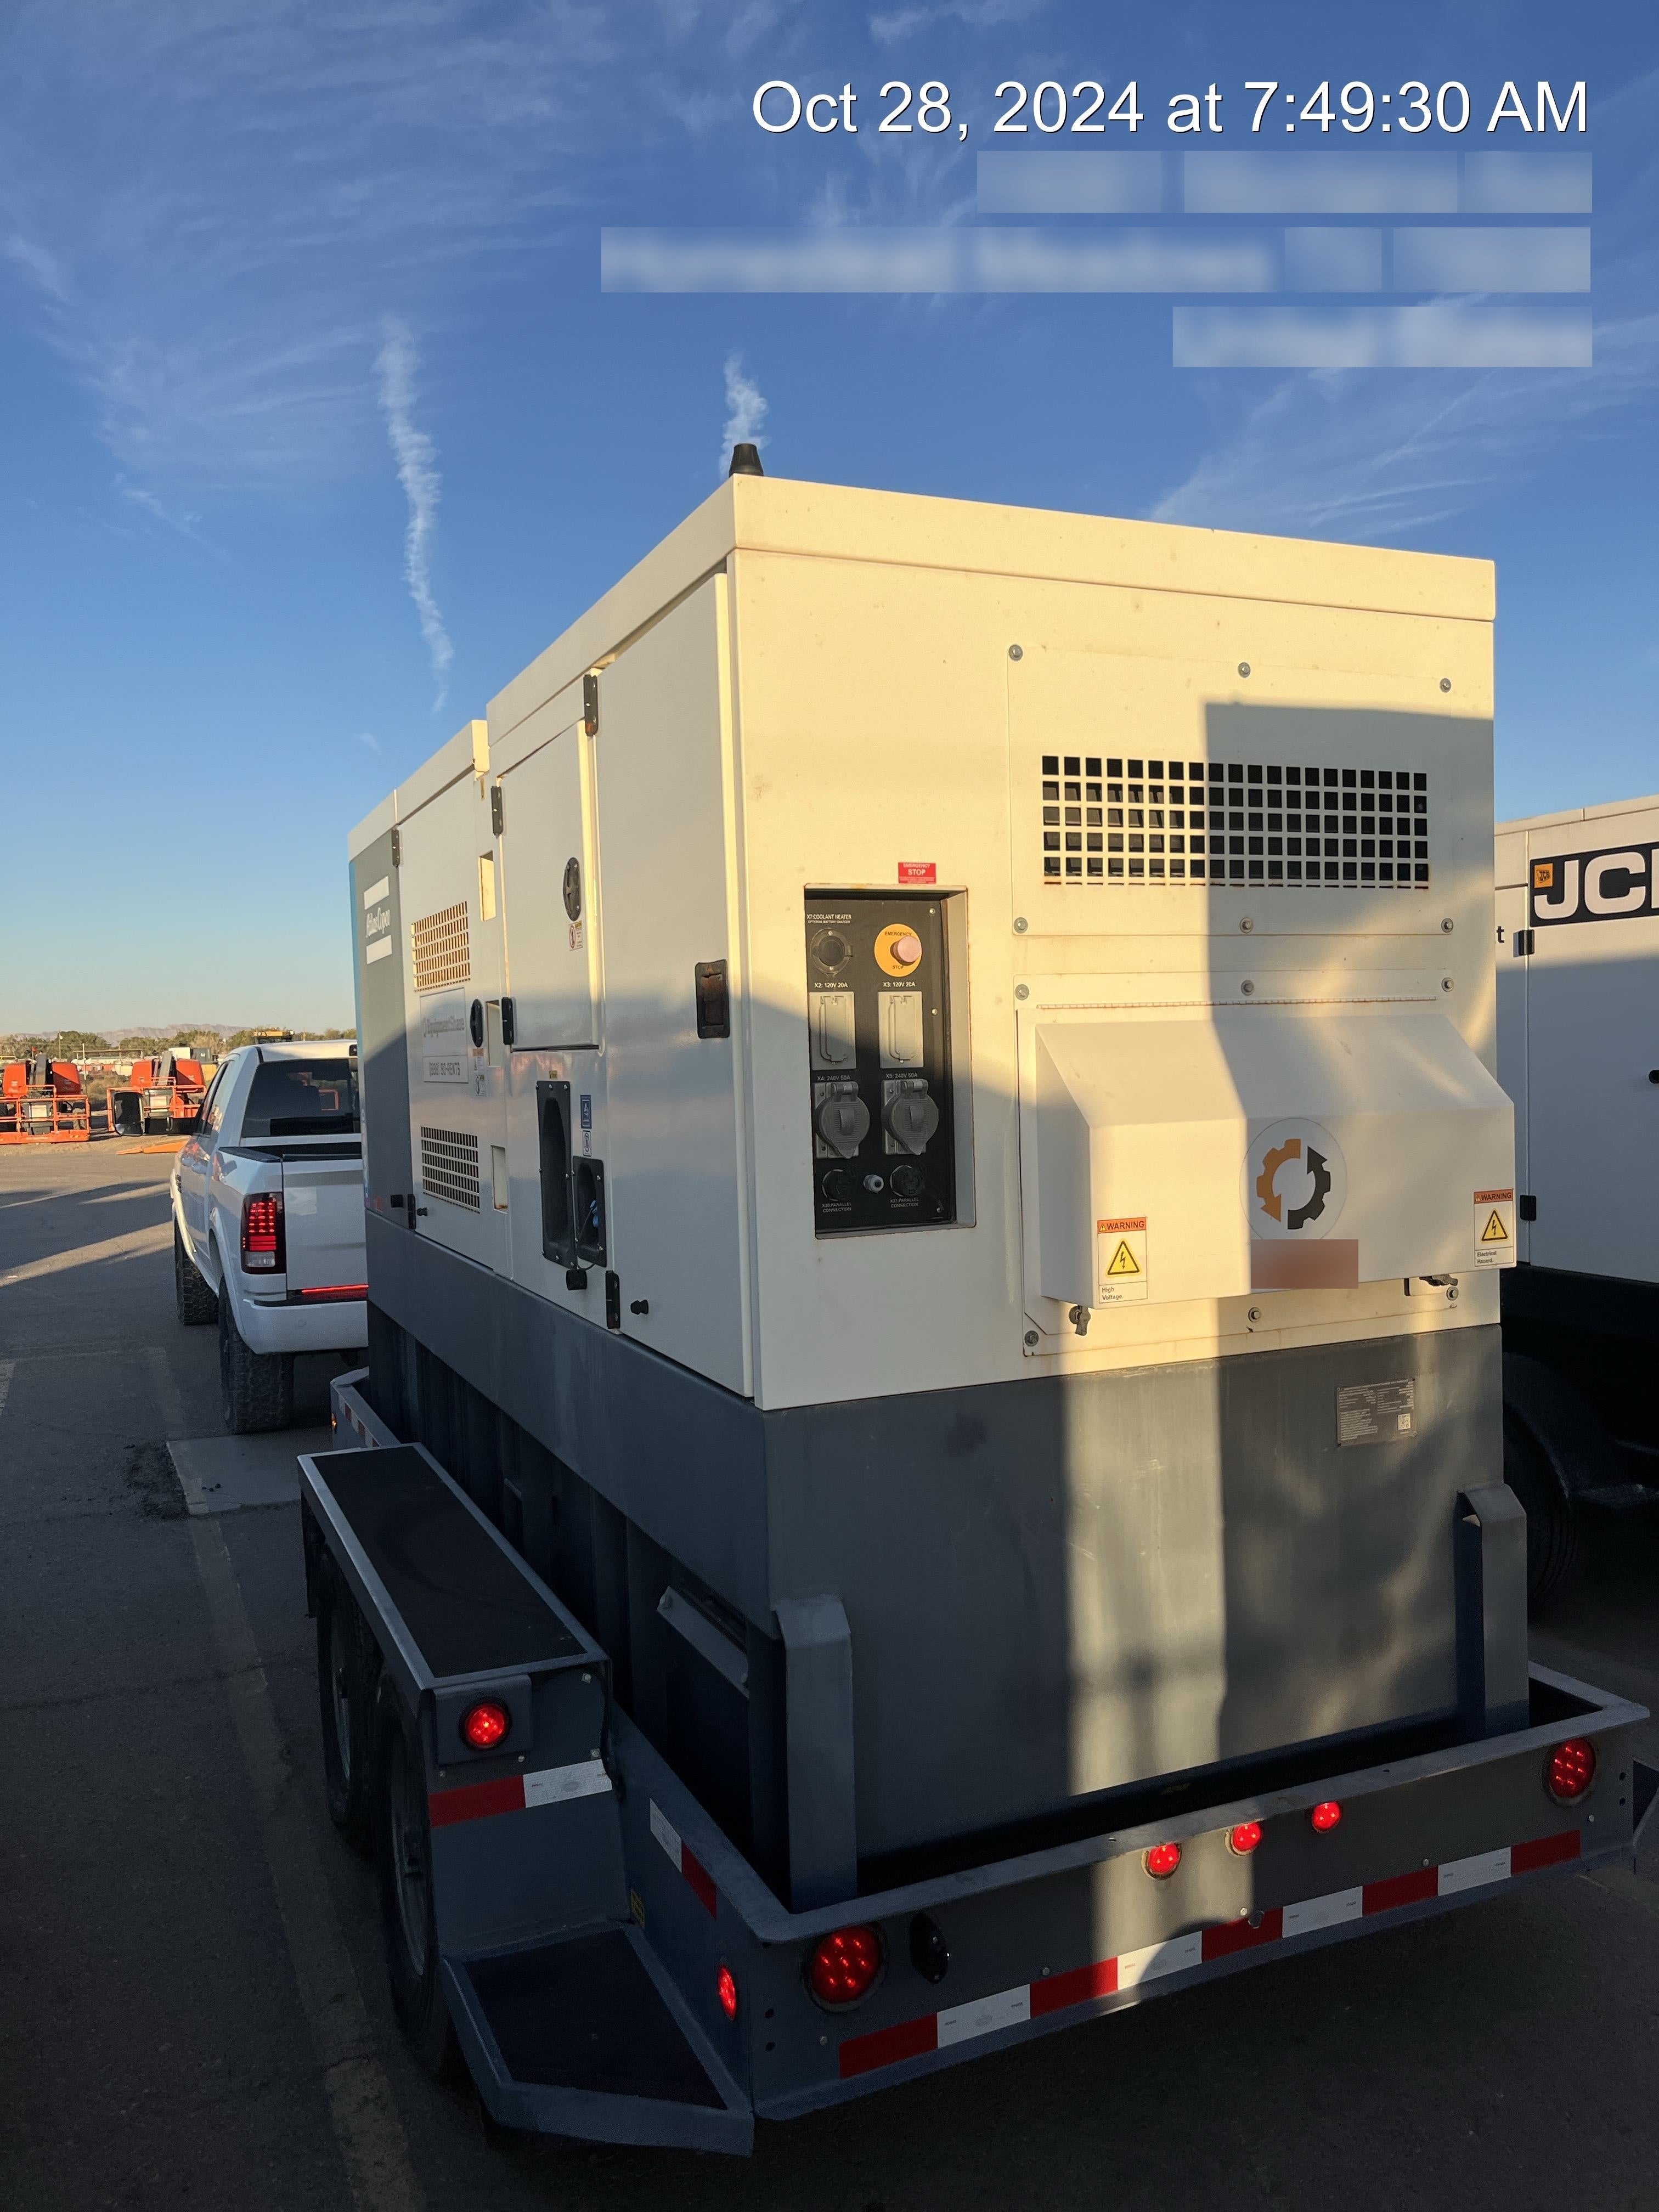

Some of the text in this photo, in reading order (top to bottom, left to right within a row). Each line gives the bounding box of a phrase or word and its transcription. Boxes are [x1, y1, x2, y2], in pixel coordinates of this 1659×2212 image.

[1534, 848, 1659, 920] JC
[1481, 1192, 1512, 1201] WARNING
[1107, 1221, 1144, 1230] WARNING
